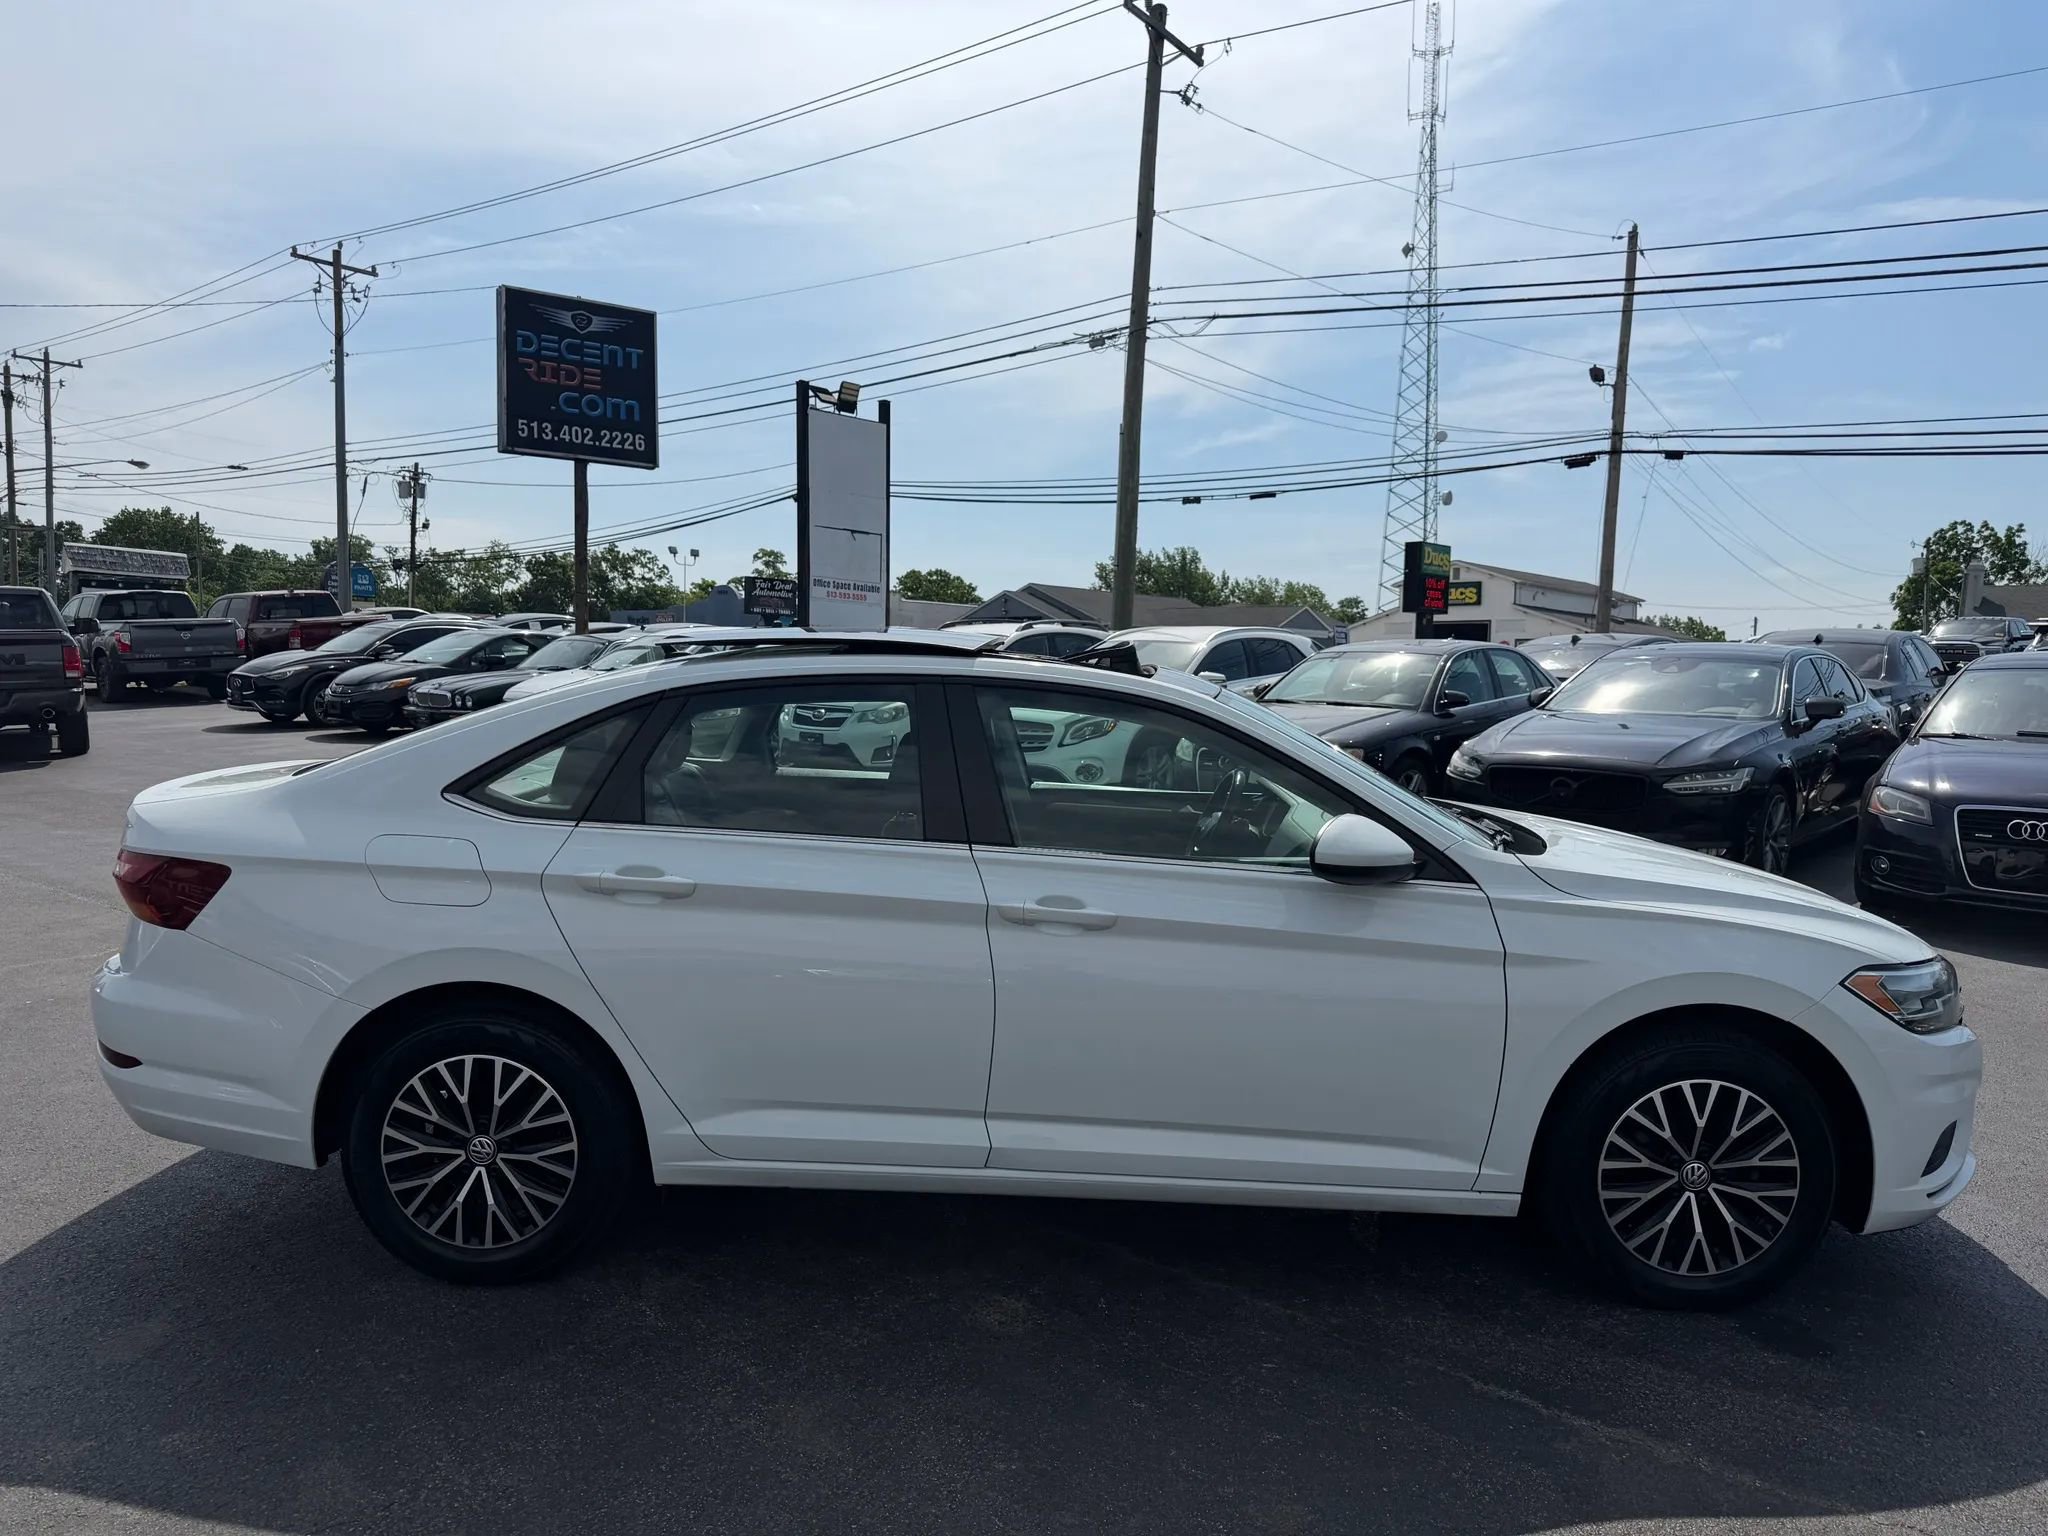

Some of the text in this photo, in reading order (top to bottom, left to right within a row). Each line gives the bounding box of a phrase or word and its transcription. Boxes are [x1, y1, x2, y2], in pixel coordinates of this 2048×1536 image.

[517, 357, 601, 389] RIDE
[517, 419, 646, 451] 513.402.2226
[755, 579, 793, 590] Fair Deal
[812, 578, 881, 594] Office Space Available
[751, 588, 793, 598] Automotive
